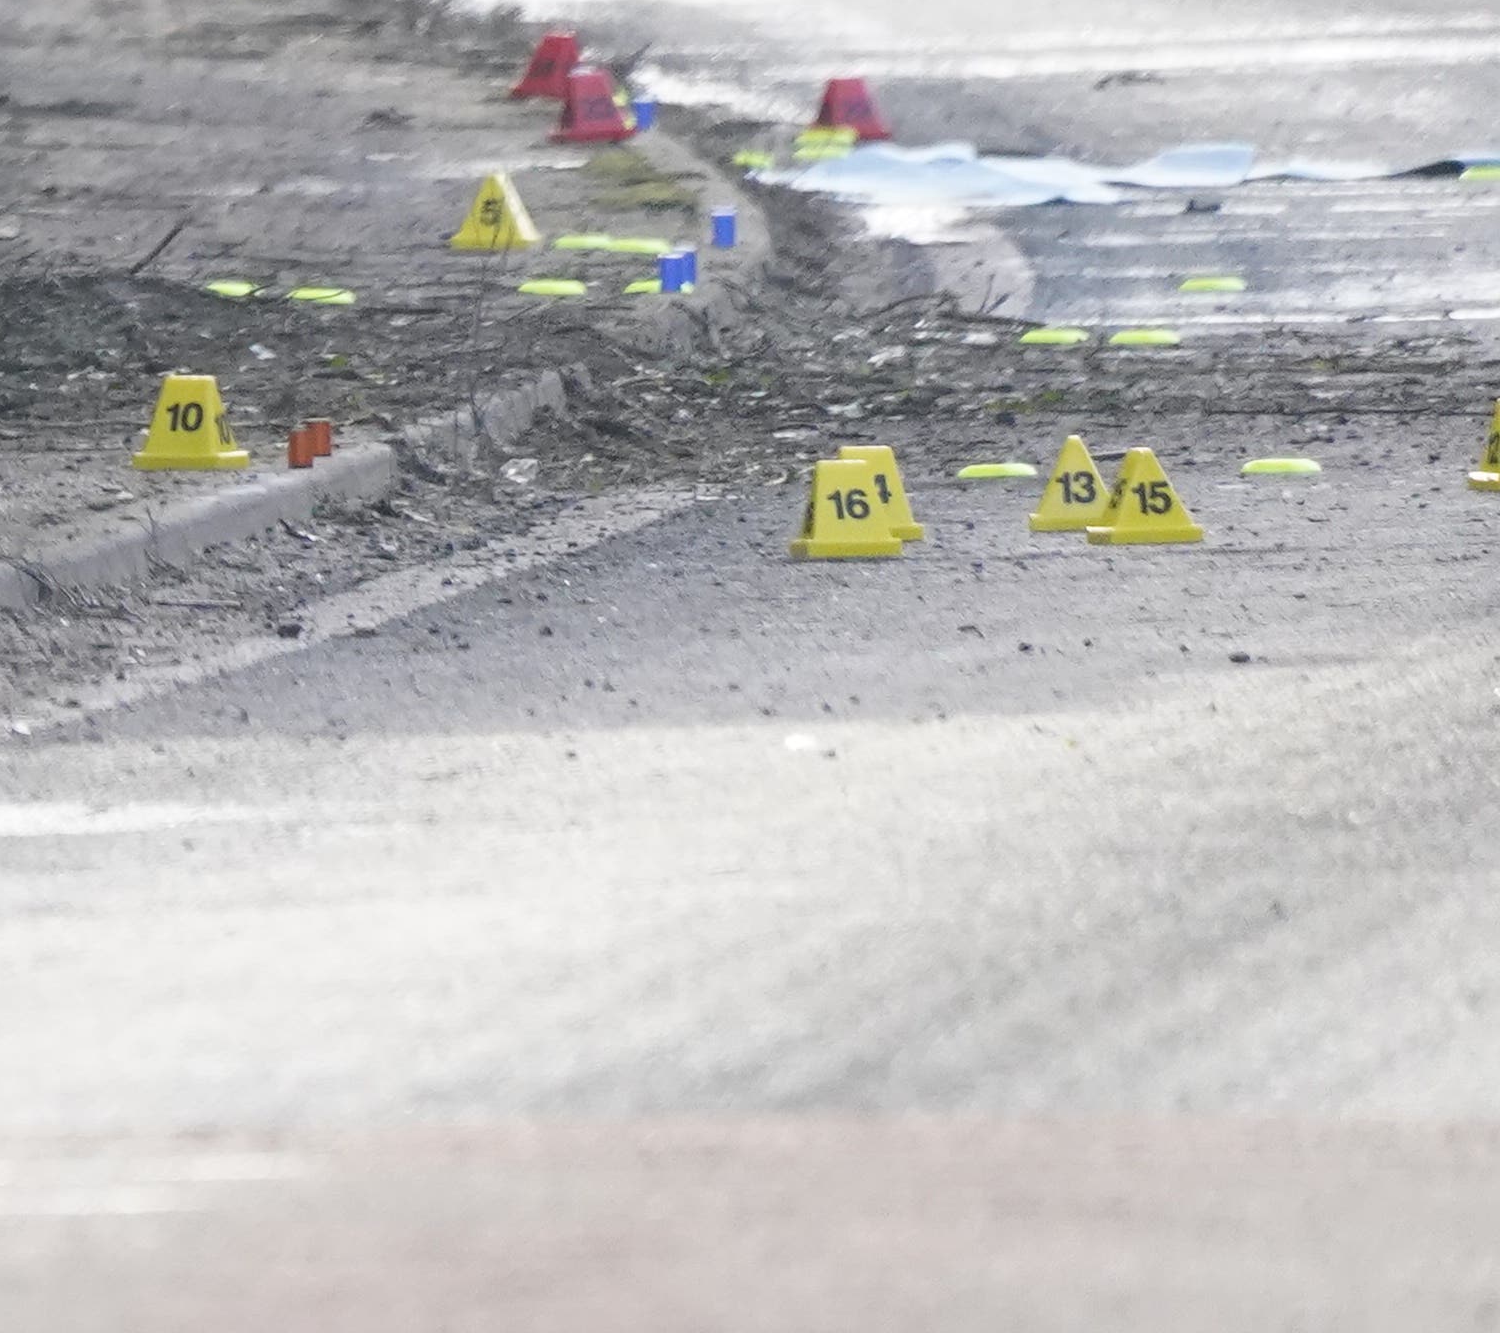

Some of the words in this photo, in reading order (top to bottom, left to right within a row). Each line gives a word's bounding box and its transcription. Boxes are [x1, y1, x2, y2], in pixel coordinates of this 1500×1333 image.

[166, 402, 203, 431] 10
[1055, 471, 1097, 504] 13
[1132, 480, 1172, 515] 15
[827, 489, 870, 520] 16
